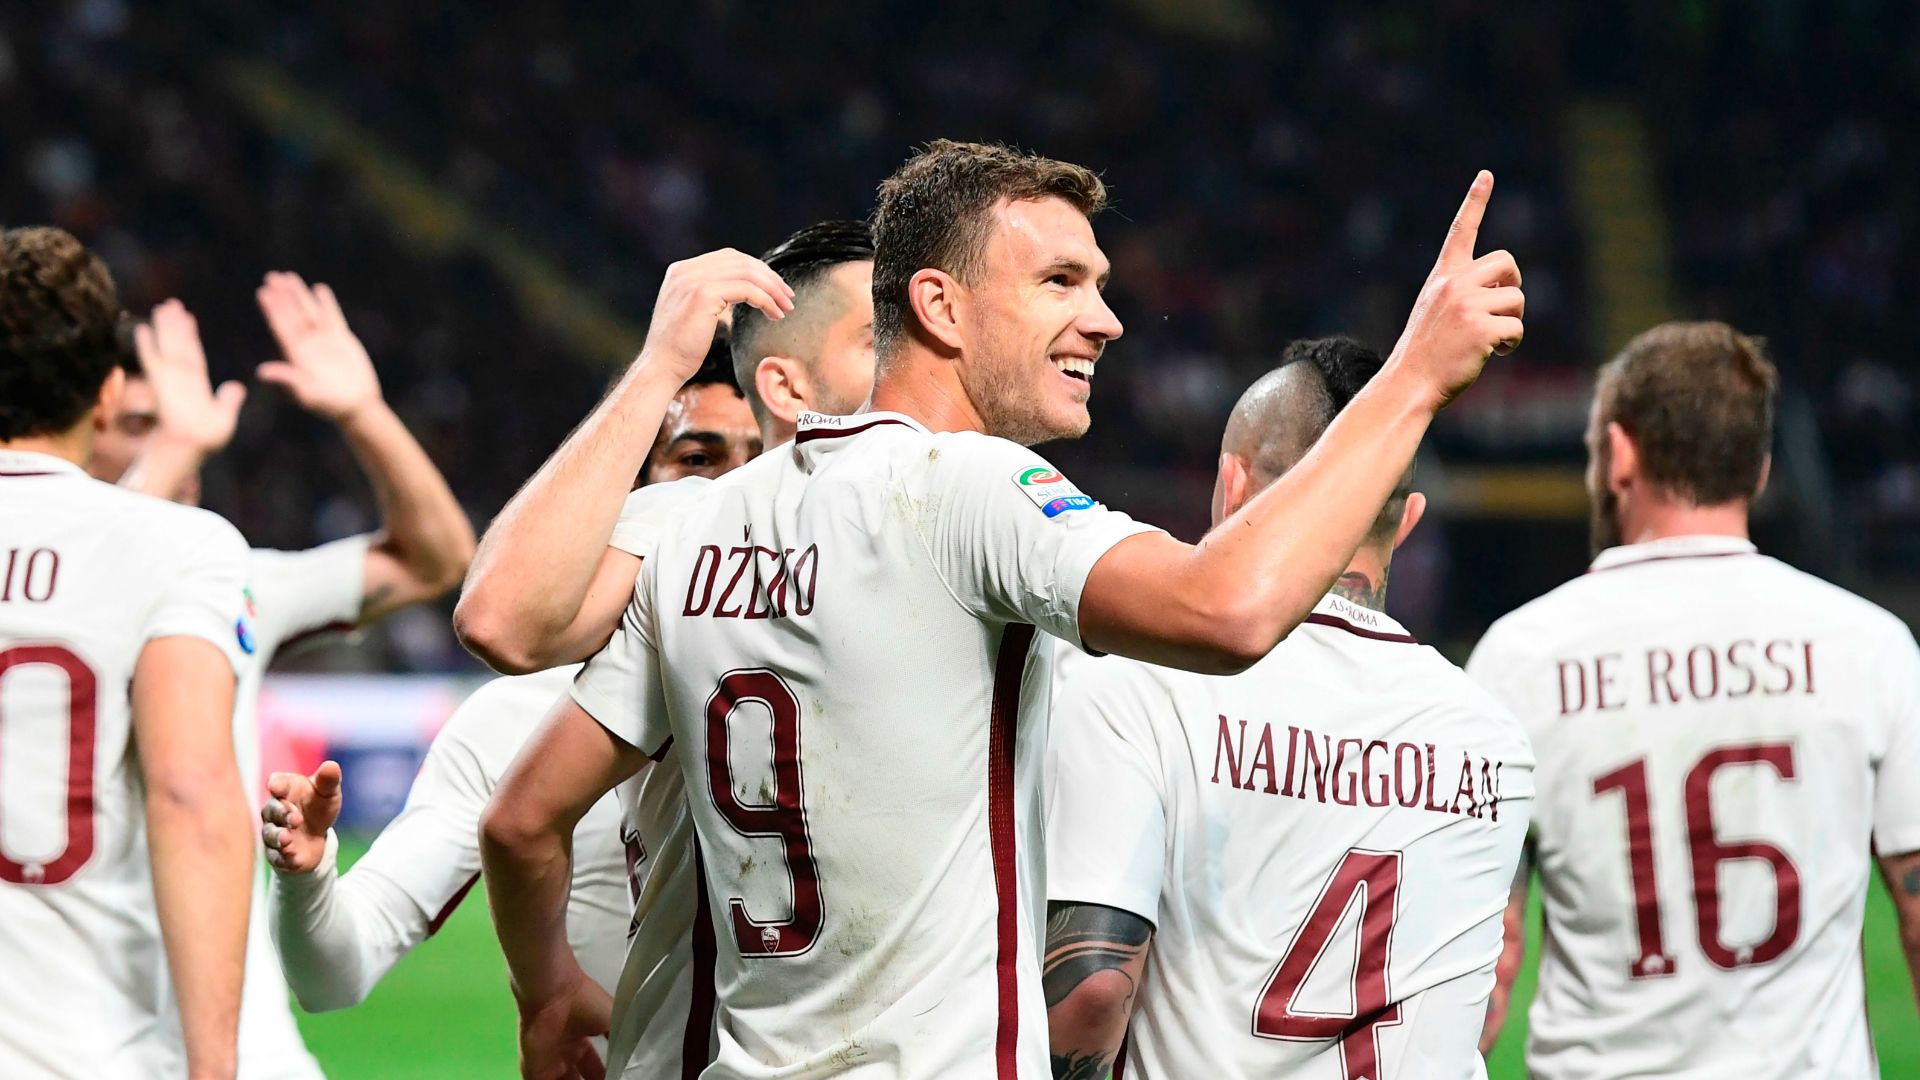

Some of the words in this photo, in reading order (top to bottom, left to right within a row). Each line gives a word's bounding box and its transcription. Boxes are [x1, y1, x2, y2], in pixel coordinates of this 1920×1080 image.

[1211, 714, 1503, 822] NAINGGOLAN
[1557, 658, 1627, 715] DE
[1646, 640, 1816, 704] ROSSI
[705, 667, 825, 958] 9
[1592, 740, 1802, 980] 16
[1252, 847, 1404, 1080] 4
